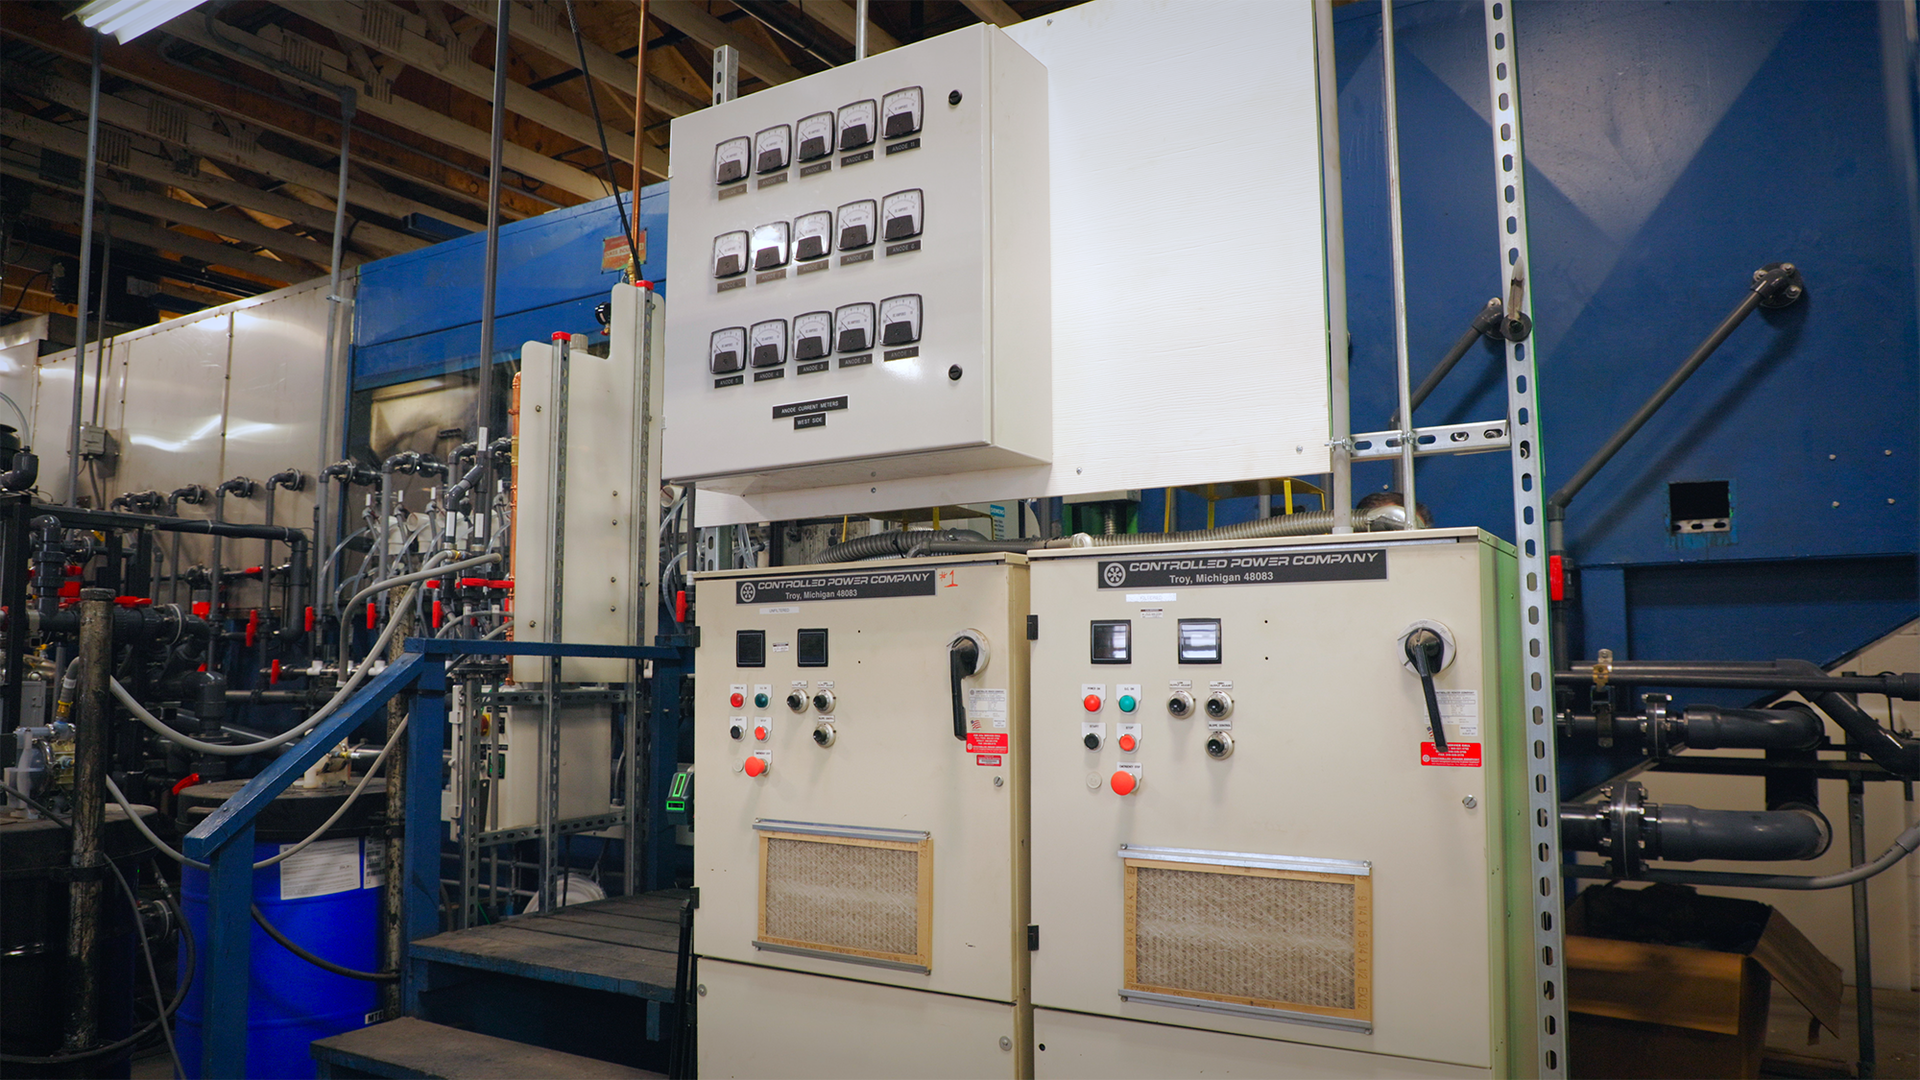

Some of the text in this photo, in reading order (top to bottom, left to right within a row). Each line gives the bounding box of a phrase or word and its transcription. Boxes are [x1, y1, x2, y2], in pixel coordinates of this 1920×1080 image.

[892, 143, 908, 152] ANODE
[846, 155, 861, 163] ANODE
[1129, 553, 1378, 572] CONTROLLED POWER COMPANY
[758, 573, 930, 590] CONTROLLED POWER COMPANY
[1170, 572, 1274, 585] Troy, Michigan 48083
[785, 589, 857, 601] Troy, Michigan 48083
